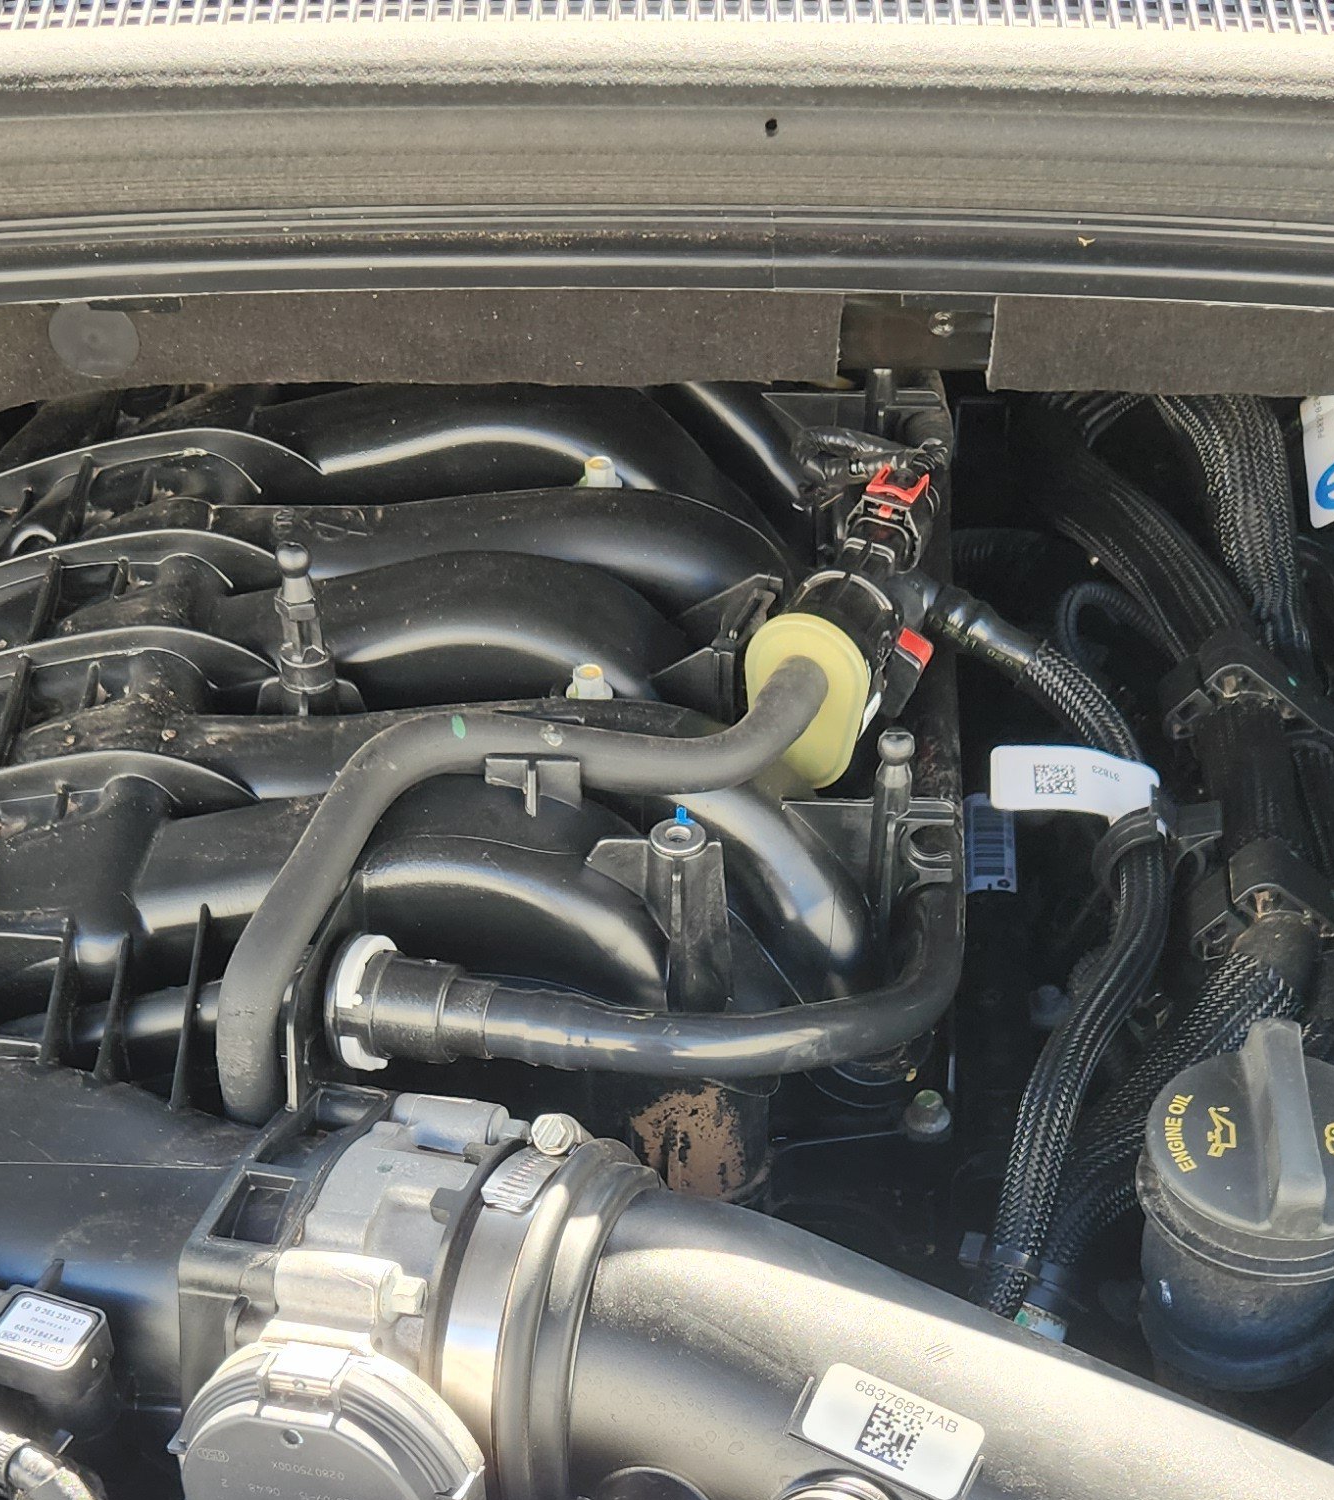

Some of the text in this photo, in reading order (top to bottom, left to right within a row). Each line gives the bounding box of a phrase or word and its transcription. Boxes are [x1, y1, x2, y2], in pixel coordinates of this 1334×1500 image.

[1163, 1092, 1198, 1174] ENGINE OIL
[21, 1337, 63, 1354] MEXICO
[854, 1379, 959, 1433] 68376821AB
